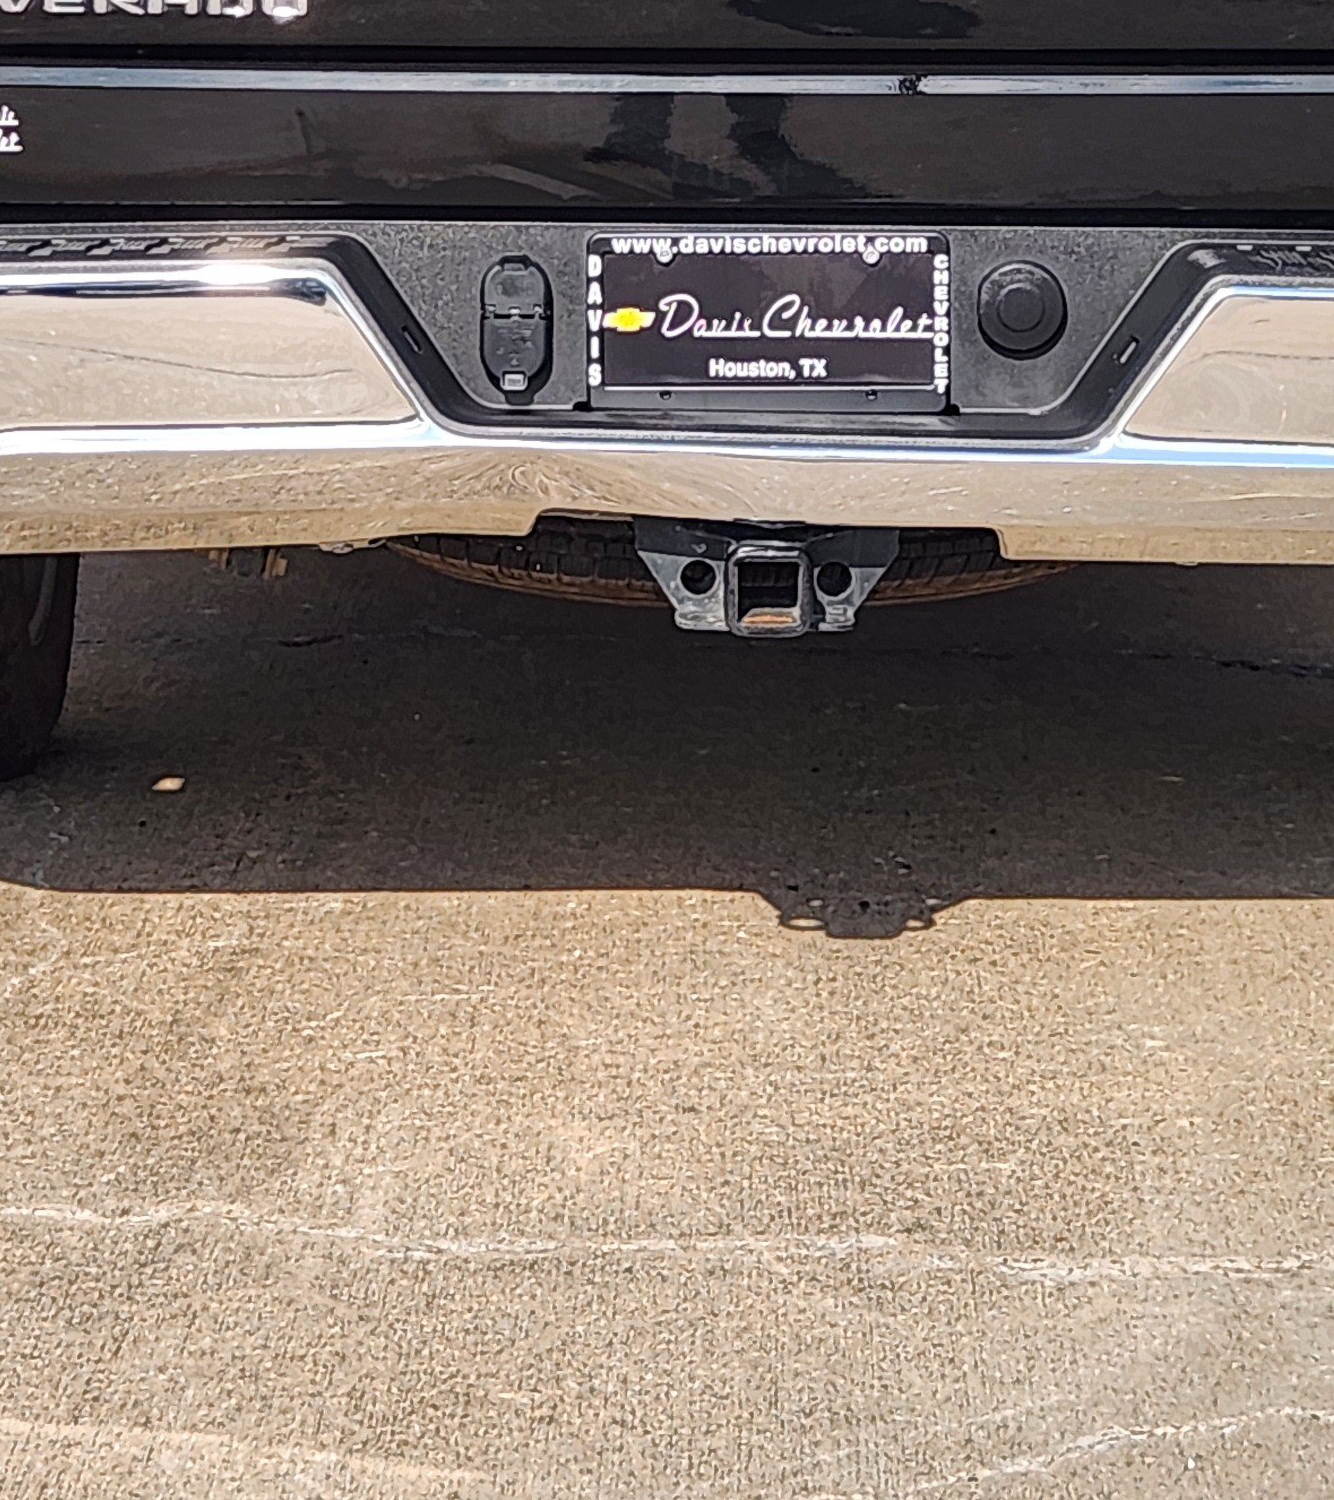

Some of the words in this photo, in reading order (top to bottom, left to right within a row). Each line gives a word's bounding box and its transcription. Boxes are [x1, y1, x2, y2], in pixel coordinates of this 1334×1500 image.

[587, 254, 603, 387] DAVIS
[659, 293, 761, 338] Davis
[763, 293, 935, 339] Chevrolet
[933, 253, 950, 394] CHEVROLET
[708, 357, 796, 380] Houston,
[798, 357, 828, 378] TX
